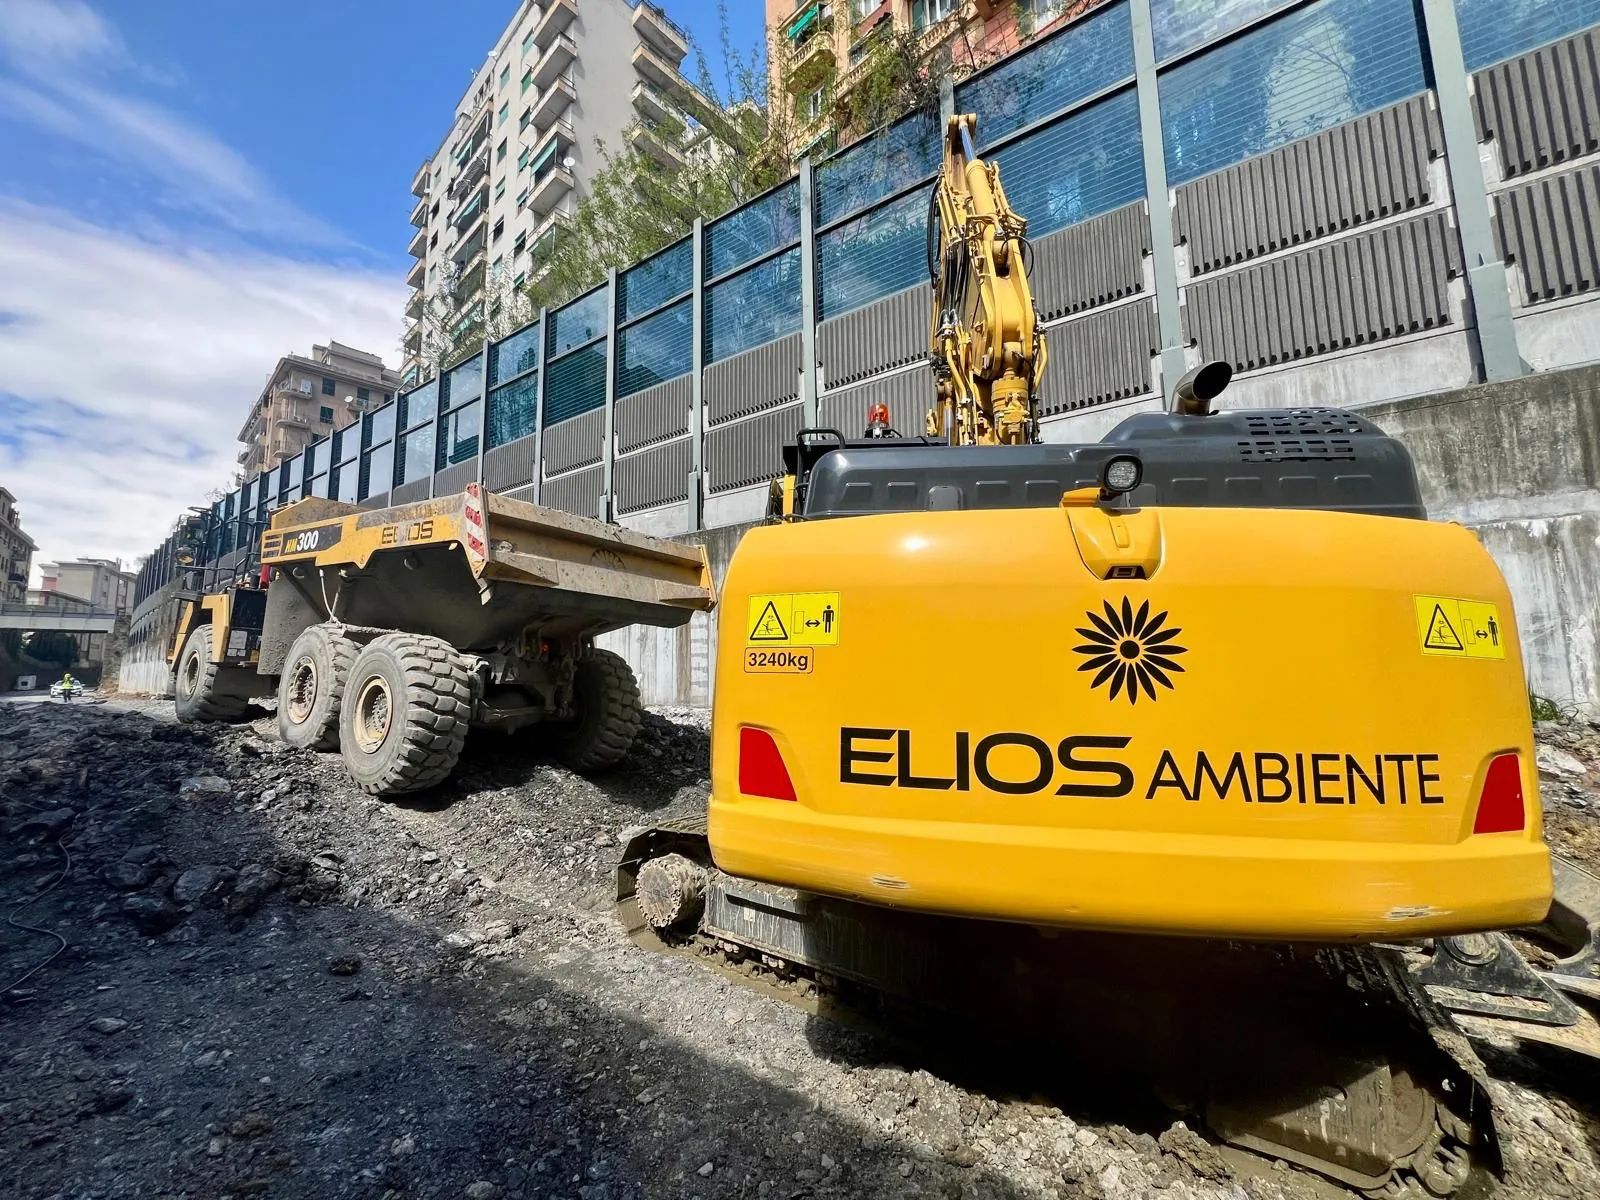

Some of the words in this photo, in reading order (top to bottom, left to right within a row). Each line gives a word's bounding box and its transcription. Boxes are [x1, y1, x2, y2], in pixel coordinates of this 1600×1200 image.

[381, 520, 434, 544] ELOS
[748, 652, 808, 671] 3240kg
[840, 726, 1135, 798] ELIOS
[1145, 750, 1445, 805] AMBIENTE
